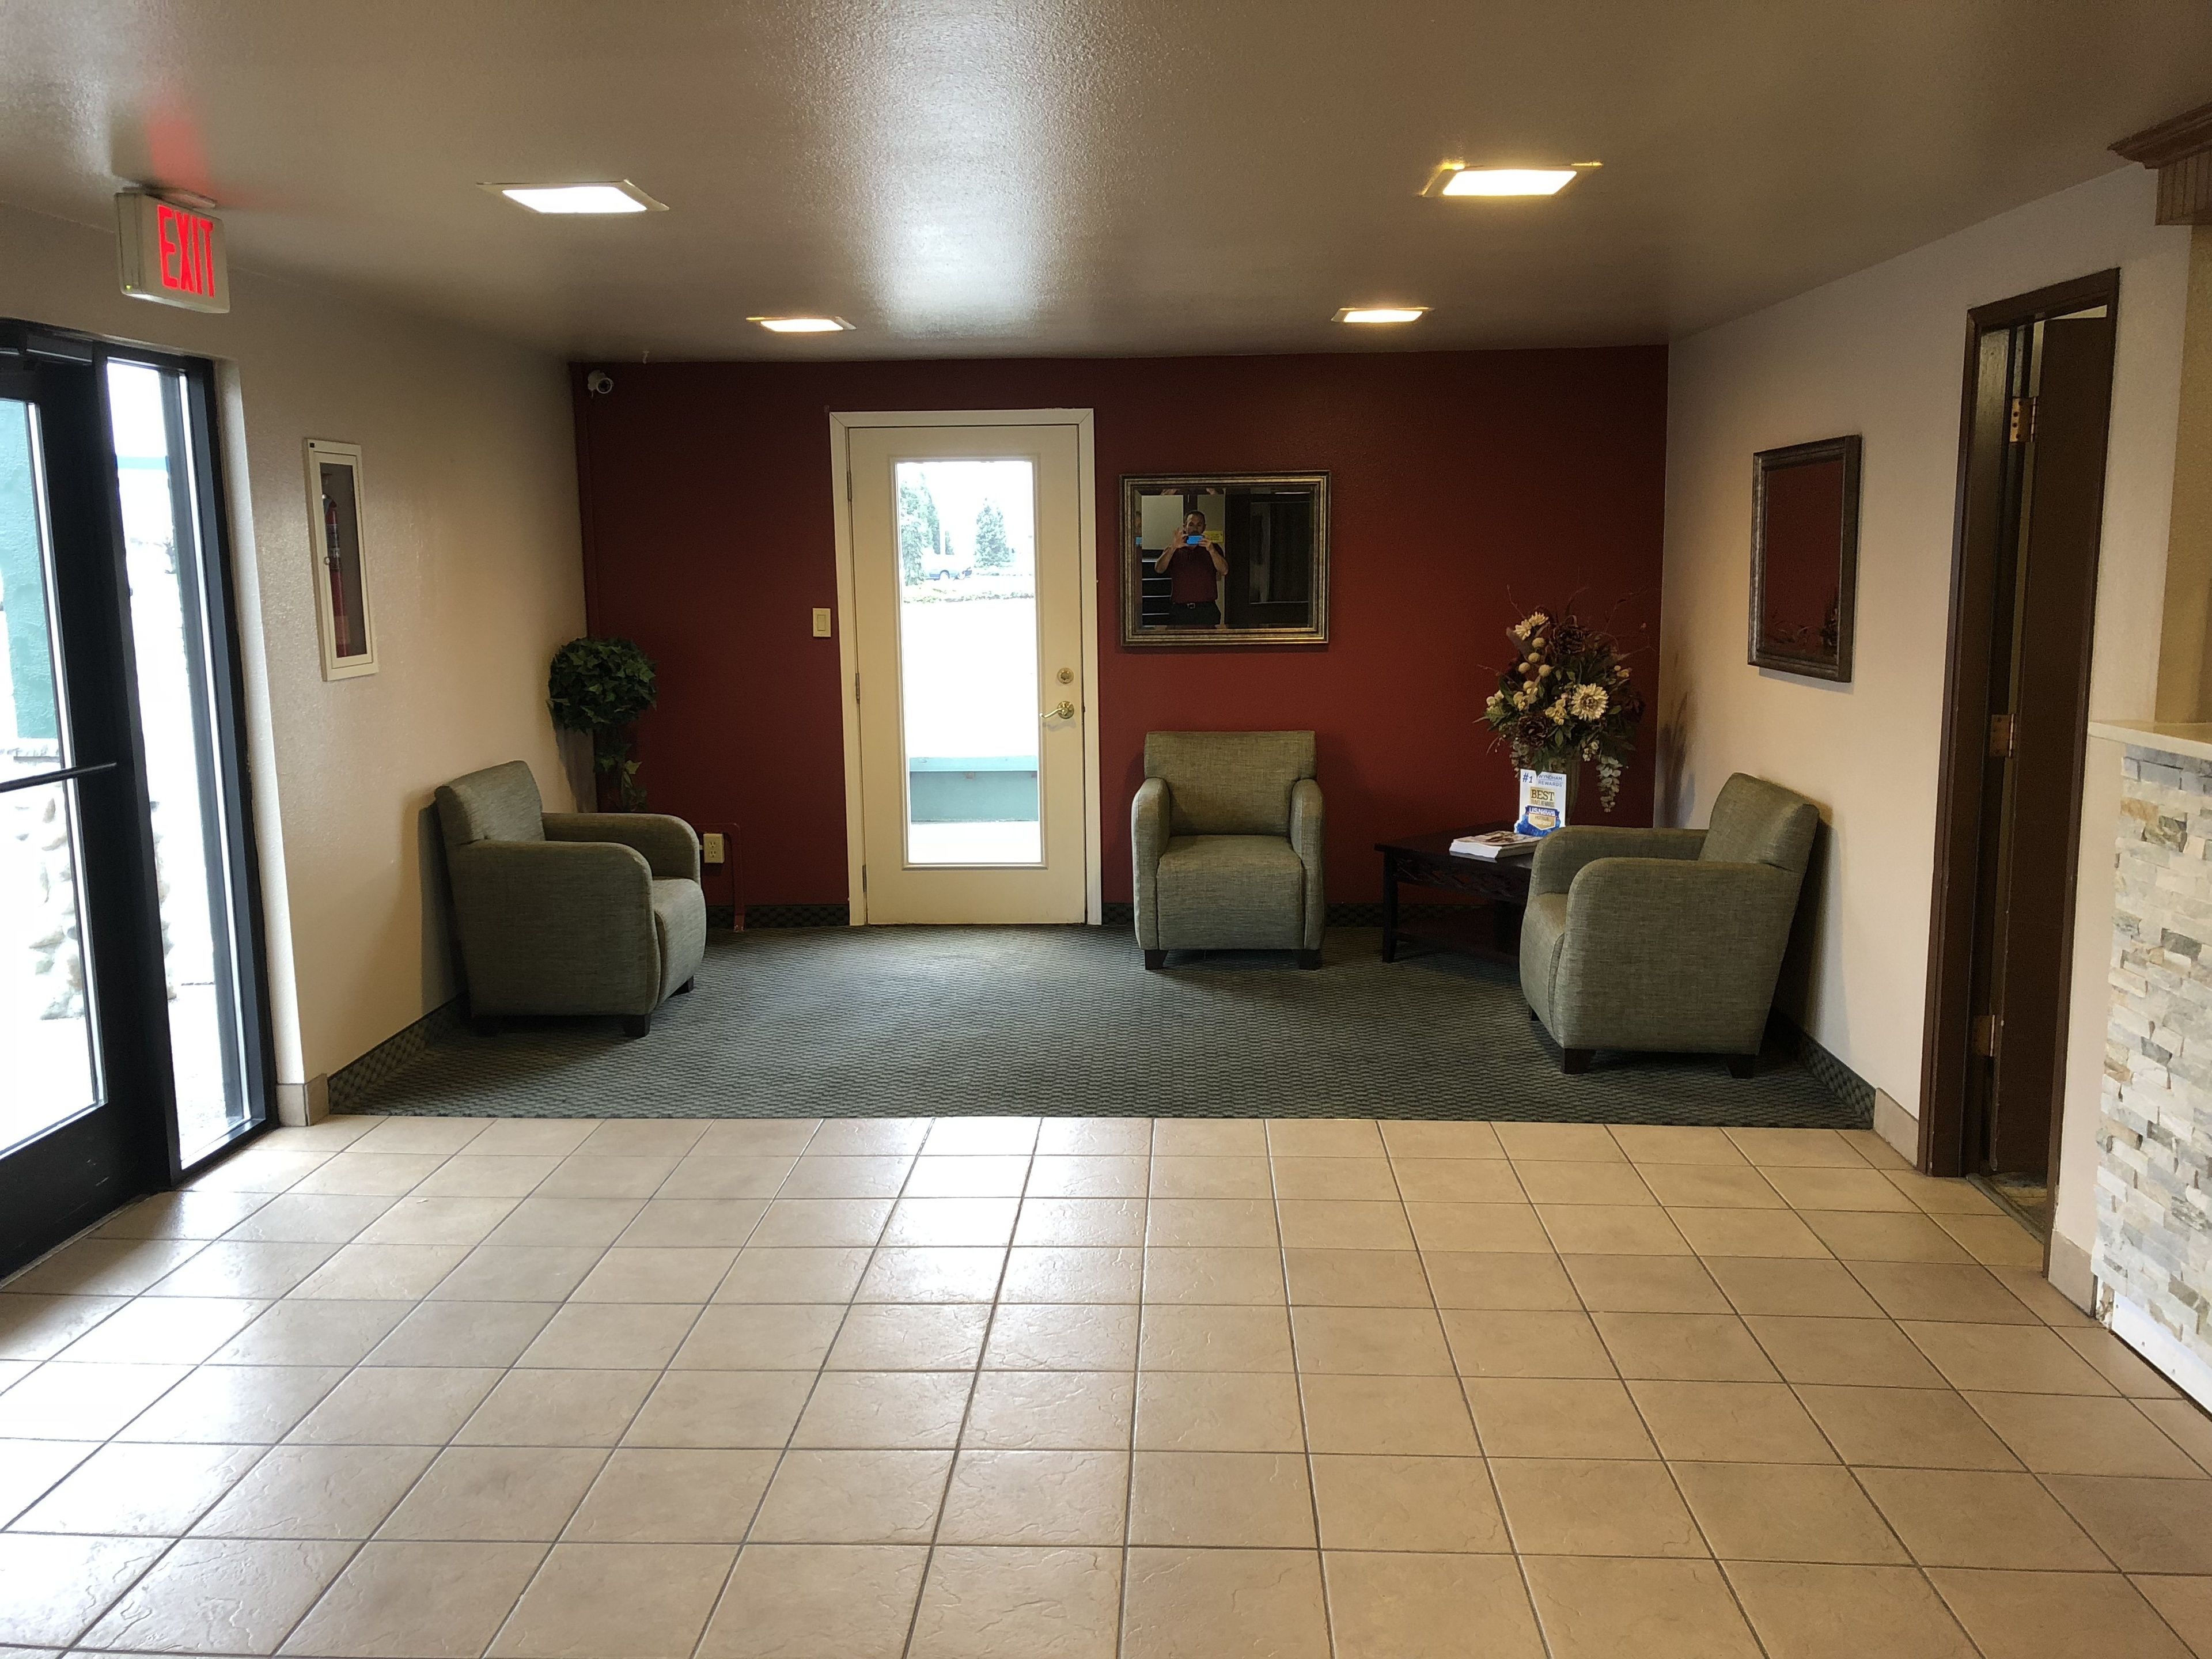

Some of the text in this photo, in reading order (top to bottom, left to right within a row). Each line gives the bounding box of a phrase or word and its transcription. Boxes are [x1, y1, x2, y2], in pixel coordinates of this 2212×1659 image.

[157, 204, 215, 298] EXIT
[1522, 772, 1533, 783] #1
[1531, 789, 1555, 801] BEST
